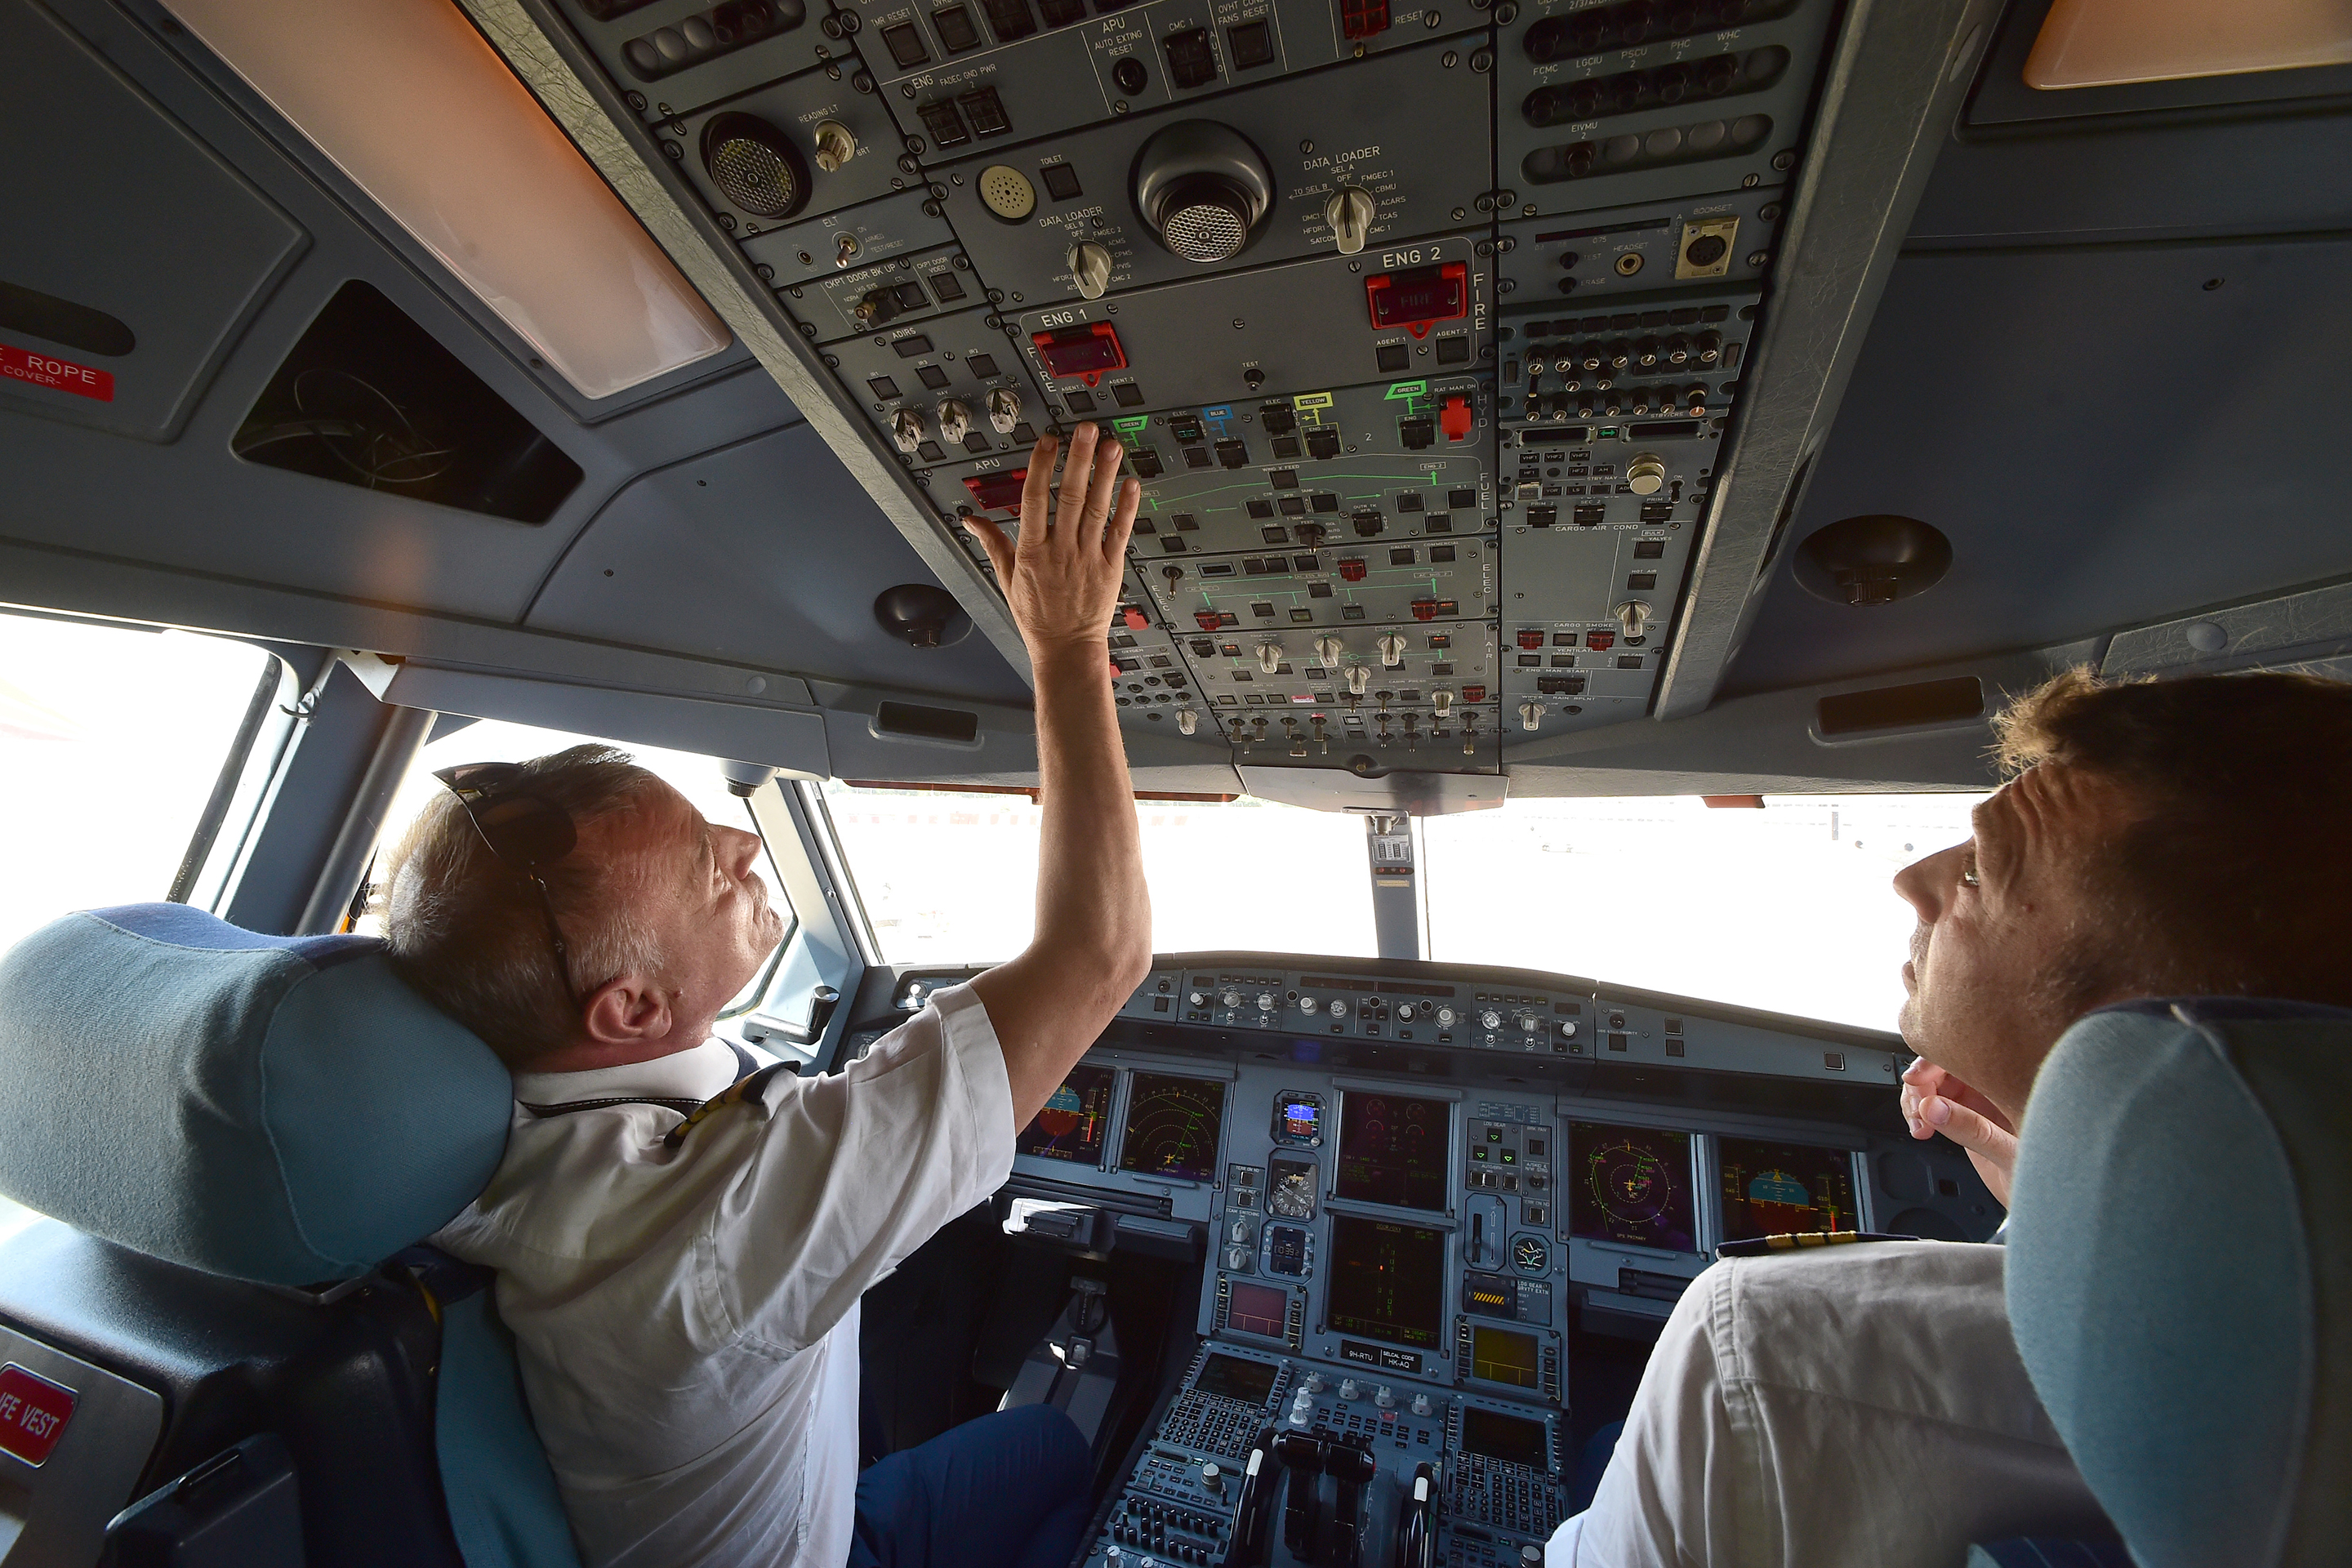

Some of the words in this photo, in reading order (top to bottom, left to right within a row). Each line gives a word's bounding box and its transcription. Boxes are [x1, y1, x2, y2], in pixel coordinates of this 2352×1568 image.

[871, 13, 884, 27] TMR
[887, 8, 911, 23] RESET
[1218, 15, 1239, 26] FANS
[1243, 5, 1269, 19] RESET
[1395, 10, 1423, 24] RESET
[1102, 16, 1125, 34] APU
[1169, 21, 1186, 33] CMC
[1189, 18, 1194, 26] 1
[1094, 38, 1114, 51] AUTO
[1116, 30, 1143, 44] EXTING
[1717, 30, 1741, 41] WHC
[1108, 43, 1134, 57] RESET
[1671, 39, 1691, 51] PHC
[1723, 42, 1730, 51] 2
[1210, 31, 1224, 73] AUTO
[1621, 47, 1648, 60] PSCU
[1677, 51, 1682, 60] 2
[1576, 56, 1602, 69] LGCIU
[1630, 59, 1637, 68] 2
[939, 74, 962, 87] FADEC
[963, 69, 978, 80] GND
[980, 64, 996, 77] PWR
[1586, 68, 1592, 76] 2
[911, 74, 934, 90] ENG
[1543, 75, 1548, 84] 2
[799, 107, 828, 124] READING
[829, 105, 840, 114] LT
[1580, 131, 1588, 140] 2
[856, 146, 871, 158] BRT
[1040, 154, 1062, 165] TOILET
[1303, 160, 1330, 172] DATA
[1336, 145, 1380, 165] LOADER
[1336, 175, 1352, 183] OFF
[1375, 183, 1396, 193] CBMU
[1380, 196, 1406, 207] ACARS
[1694, 204, 1732, 216] BOOMSET
[822, 216, 840, 229] ELT
[1039, 217, 1062, 228] DATA
[1065, 206, 1103, 223] LOADER
[1379, 212, 1398, 221] TCAS
[1071, 229, 1085, 237] OFF
[1117, 225, 1122, 234] 2
[864, 233, 885, 243] ARMED
[1107, 238, 1125, 247] ACMS
[1310, 235, 1336, 245] SATCOM
[1613, 242, 1648, 252] HEADSET
[1114, 249, 1133, 258] CPMS
[1382, 255, 1421, 268] ENG
[1431, 247, 1441, 261] 2
[1584, 253, 1601, 261] TEST
[916, 261, 932, 270] CKPT
[933, 256, 949, 266] DOOR
[1116, 262, 1132, 271] PVIS
[928, 265, 946, 274] VIDEO
[825, 278, 846, 290] CKPT
[847, 271, 869, 284] DOOR
[871, 266, 884, 278] BK
[885, 263, 897, 273] UP
[1111, 274, 1127, 283] CMC
[1581, 278, 1606, 286] ERASE
[1472, 273, 1486, 330] FIRE
[1040, 314, 1074, 327] ENG
[1080, 309, 1088, 320] 1
[892, 327, 916, 340] ADIRS
[1436, 330, 1460, 338] AGENT
[28, 355, 96, 385] ROPE
[1026, 346, 1058, 393] FIRE
[1396, 385, 1419, 394] GREEN
[1477, 395, 1488, 428] HYD
[1365, 433, 1372, 441] 2
[974, 459, 1001, 471] APU
[1480, 472, 1490, 510] FUEL
[1482, 564, 1491, 594] ELEC
[1152, 585, 1169, 611] ELEC
[1485, 642, 1494, 660] AIR
[1349, 1351, 1374, 1361] 9H-RTU
[1383, 1351, 1400, 1359] SELCAL
[1388, 1359, 1410, 1369] HK-AQ
[20, 1404, 60, 1439] VEST
